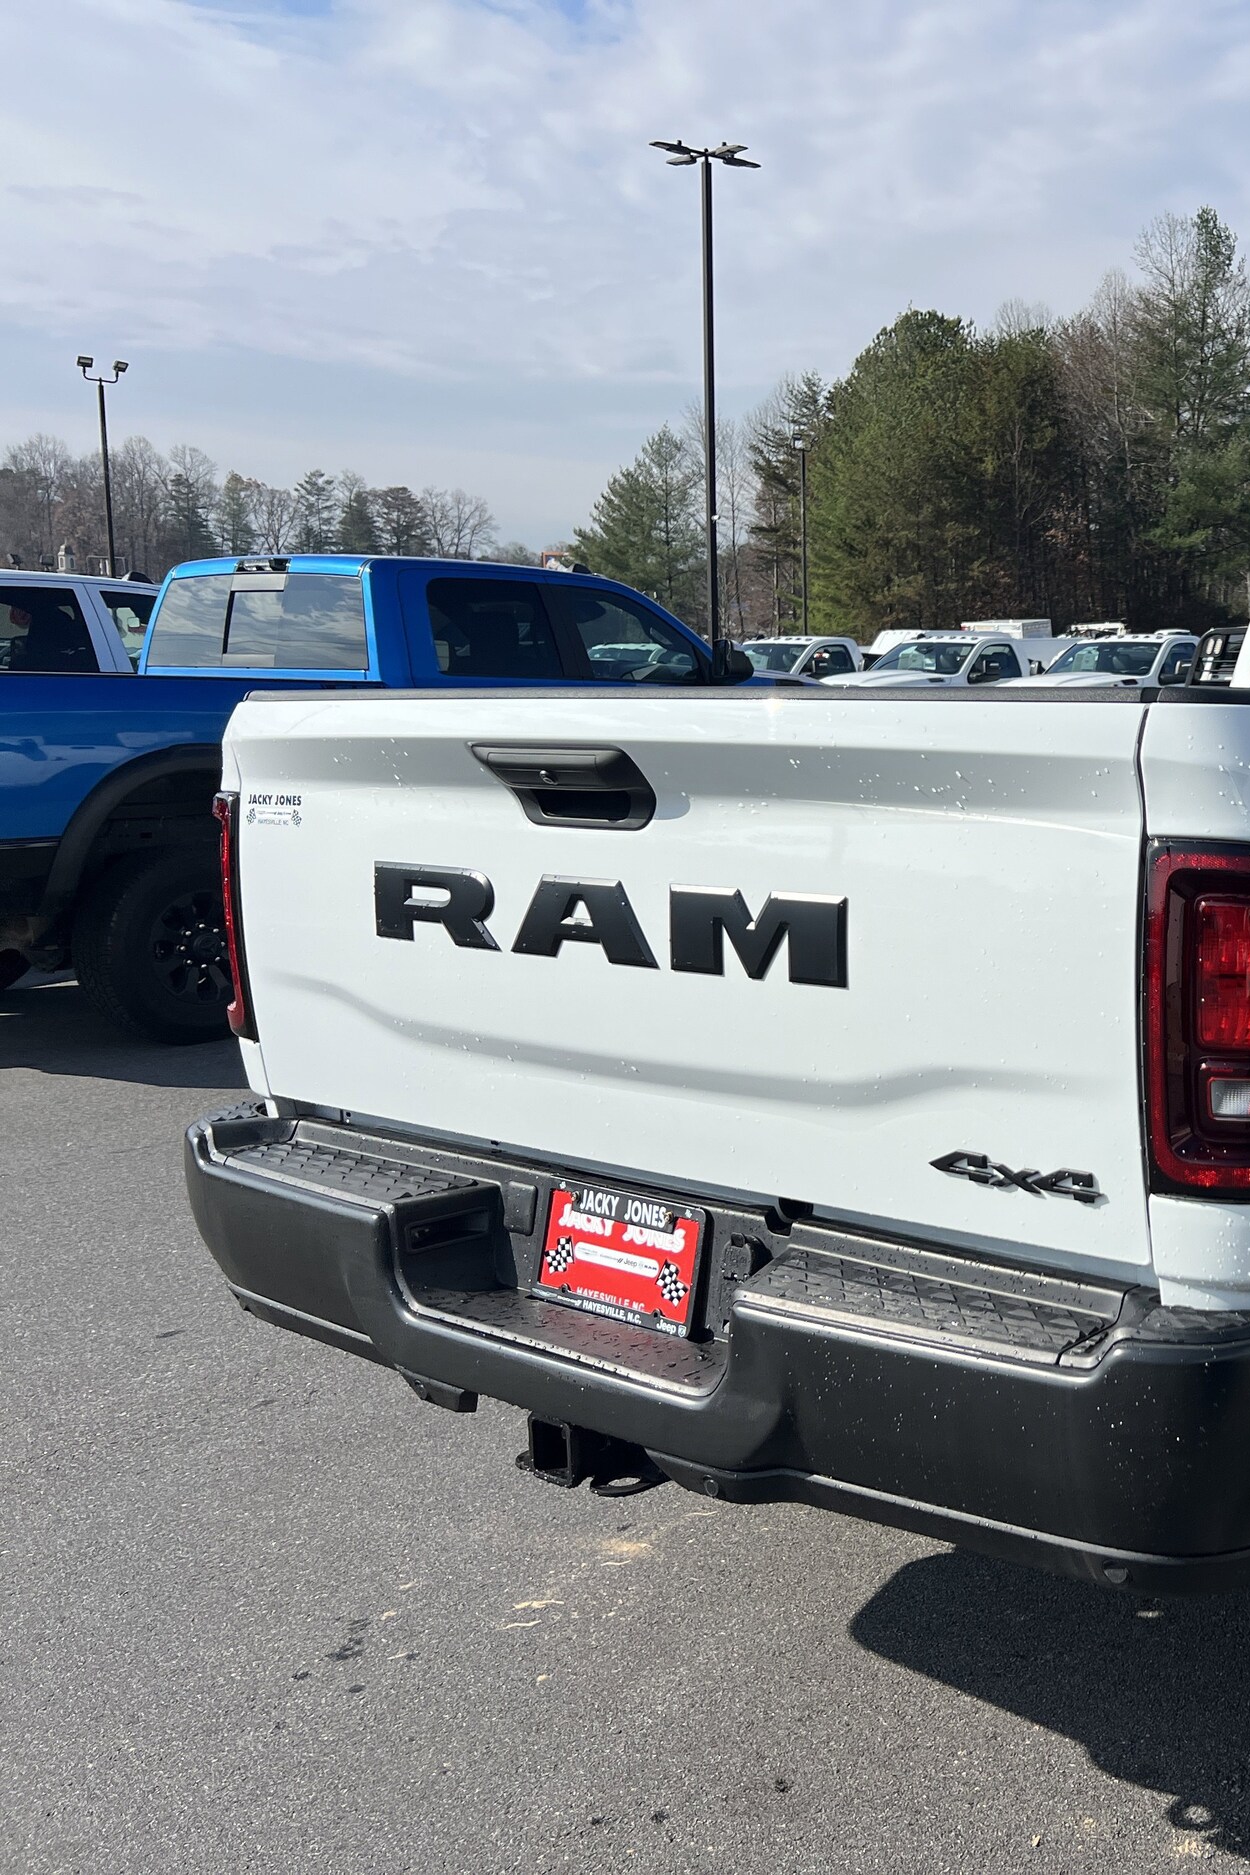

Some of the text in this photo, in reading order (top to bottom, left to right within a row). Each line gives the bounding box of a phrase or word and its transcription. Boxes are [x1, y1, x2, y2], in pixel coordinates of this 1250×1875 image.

[248, 794, 302, 806] JACKY JONES
[373, 860, 849, 989] RAM
[579, 1189, 666, 1228] JACKY JONES
[656, 1319, 677, 1335] Jeep
